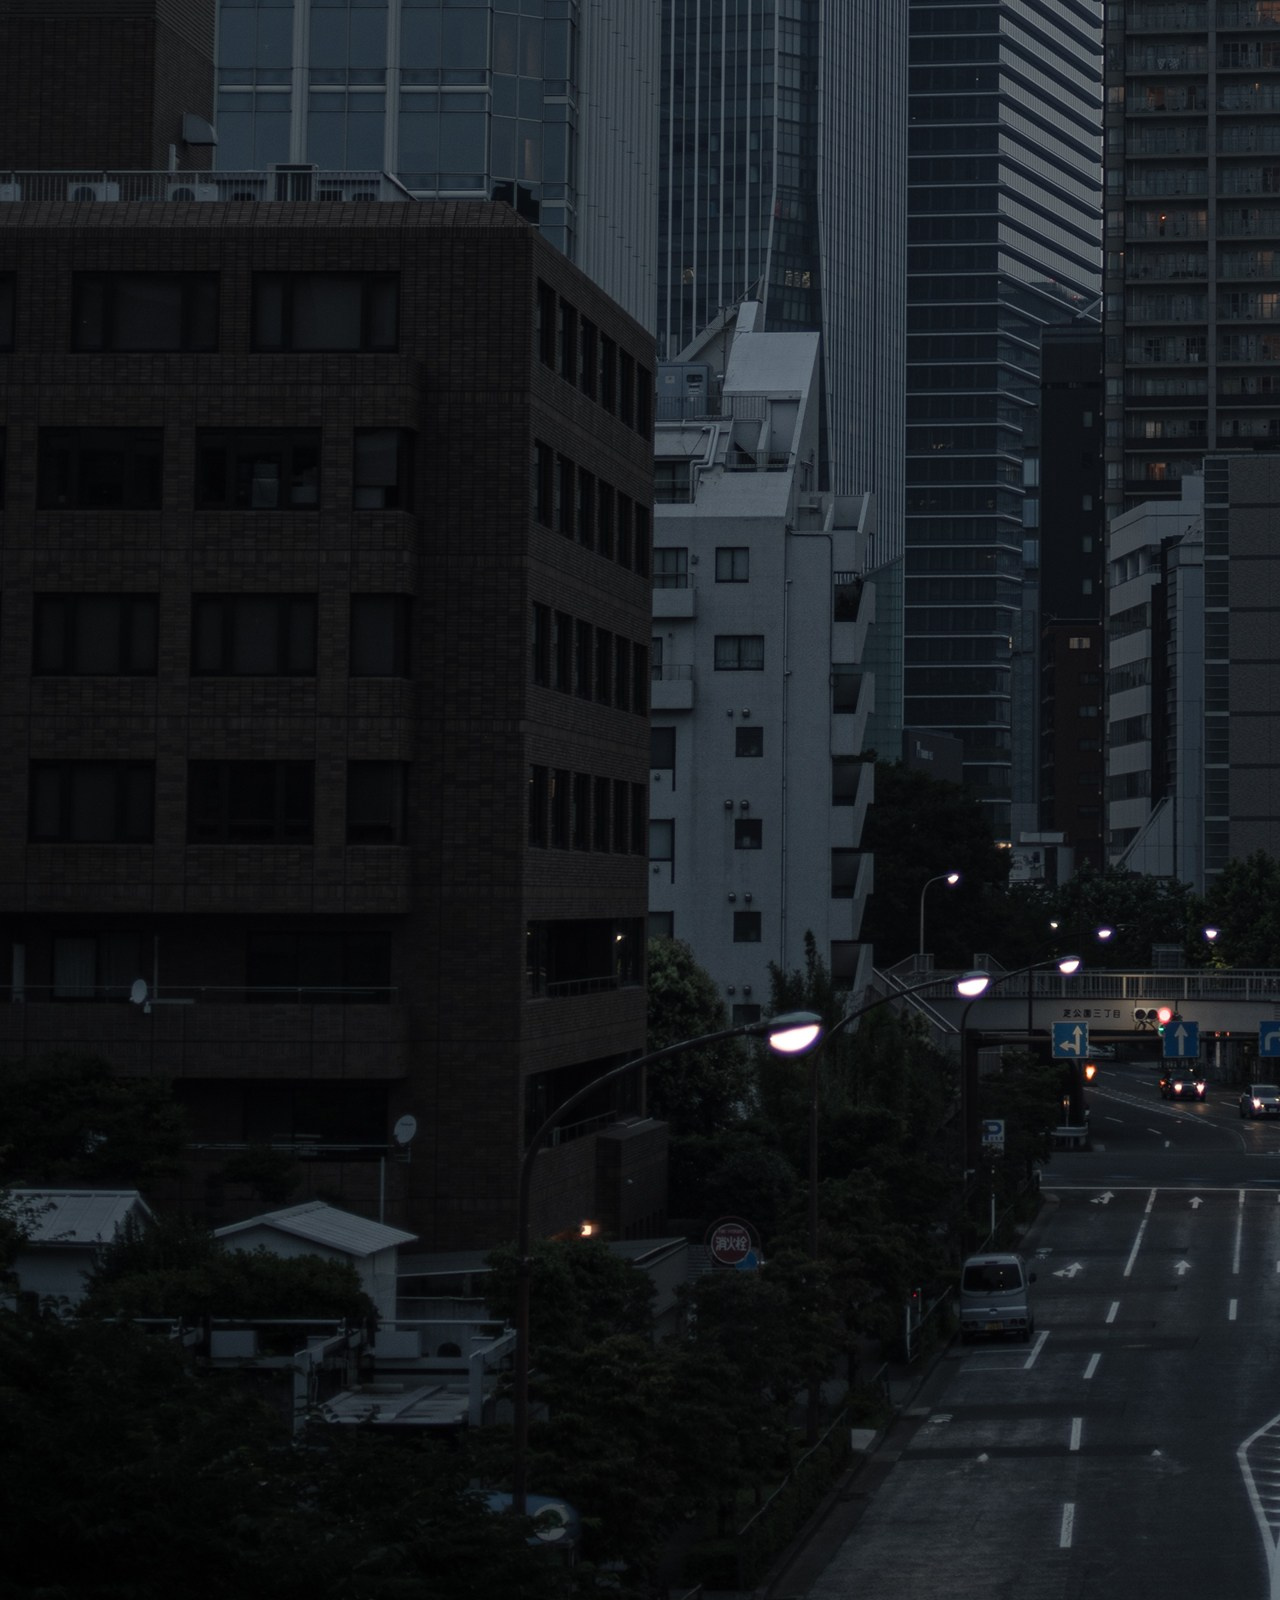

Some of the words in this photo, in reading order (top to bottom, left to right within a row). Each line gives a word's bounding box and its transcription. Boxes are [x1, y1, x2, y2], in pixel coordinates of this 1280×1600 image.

[1063, 1009, 1121, 1019] 芝公園三丁目
[715, 1236, 748, 1251] 消火栓
